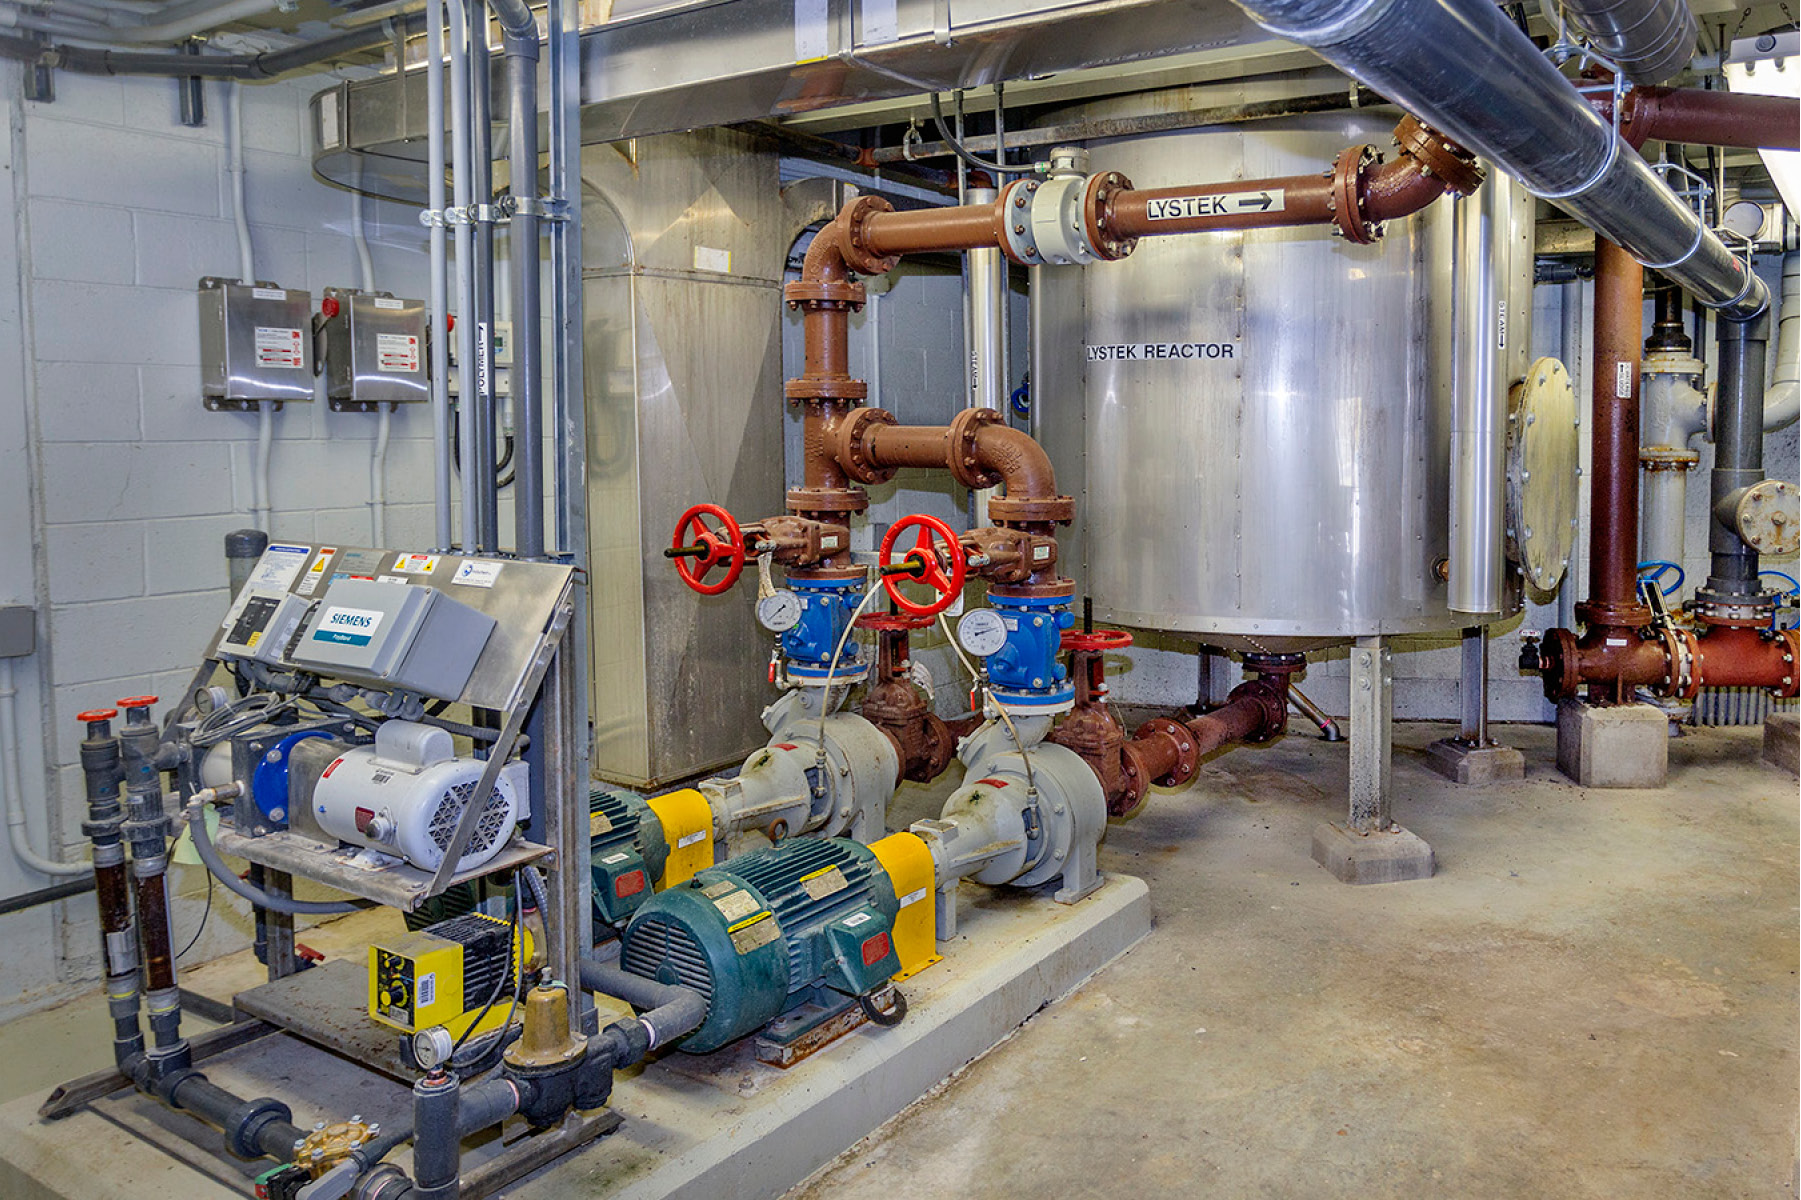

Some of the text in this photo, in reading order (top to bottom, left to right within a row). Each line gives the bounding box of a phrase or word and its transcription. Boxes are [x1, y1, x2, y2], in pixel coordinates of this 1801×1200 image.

[1148, 195, 1228, 219] LYSTEK
[1087, 343, 1234, 361] LYSTEK REACTOR
[330, 612, 373, 628] SIEMENS
